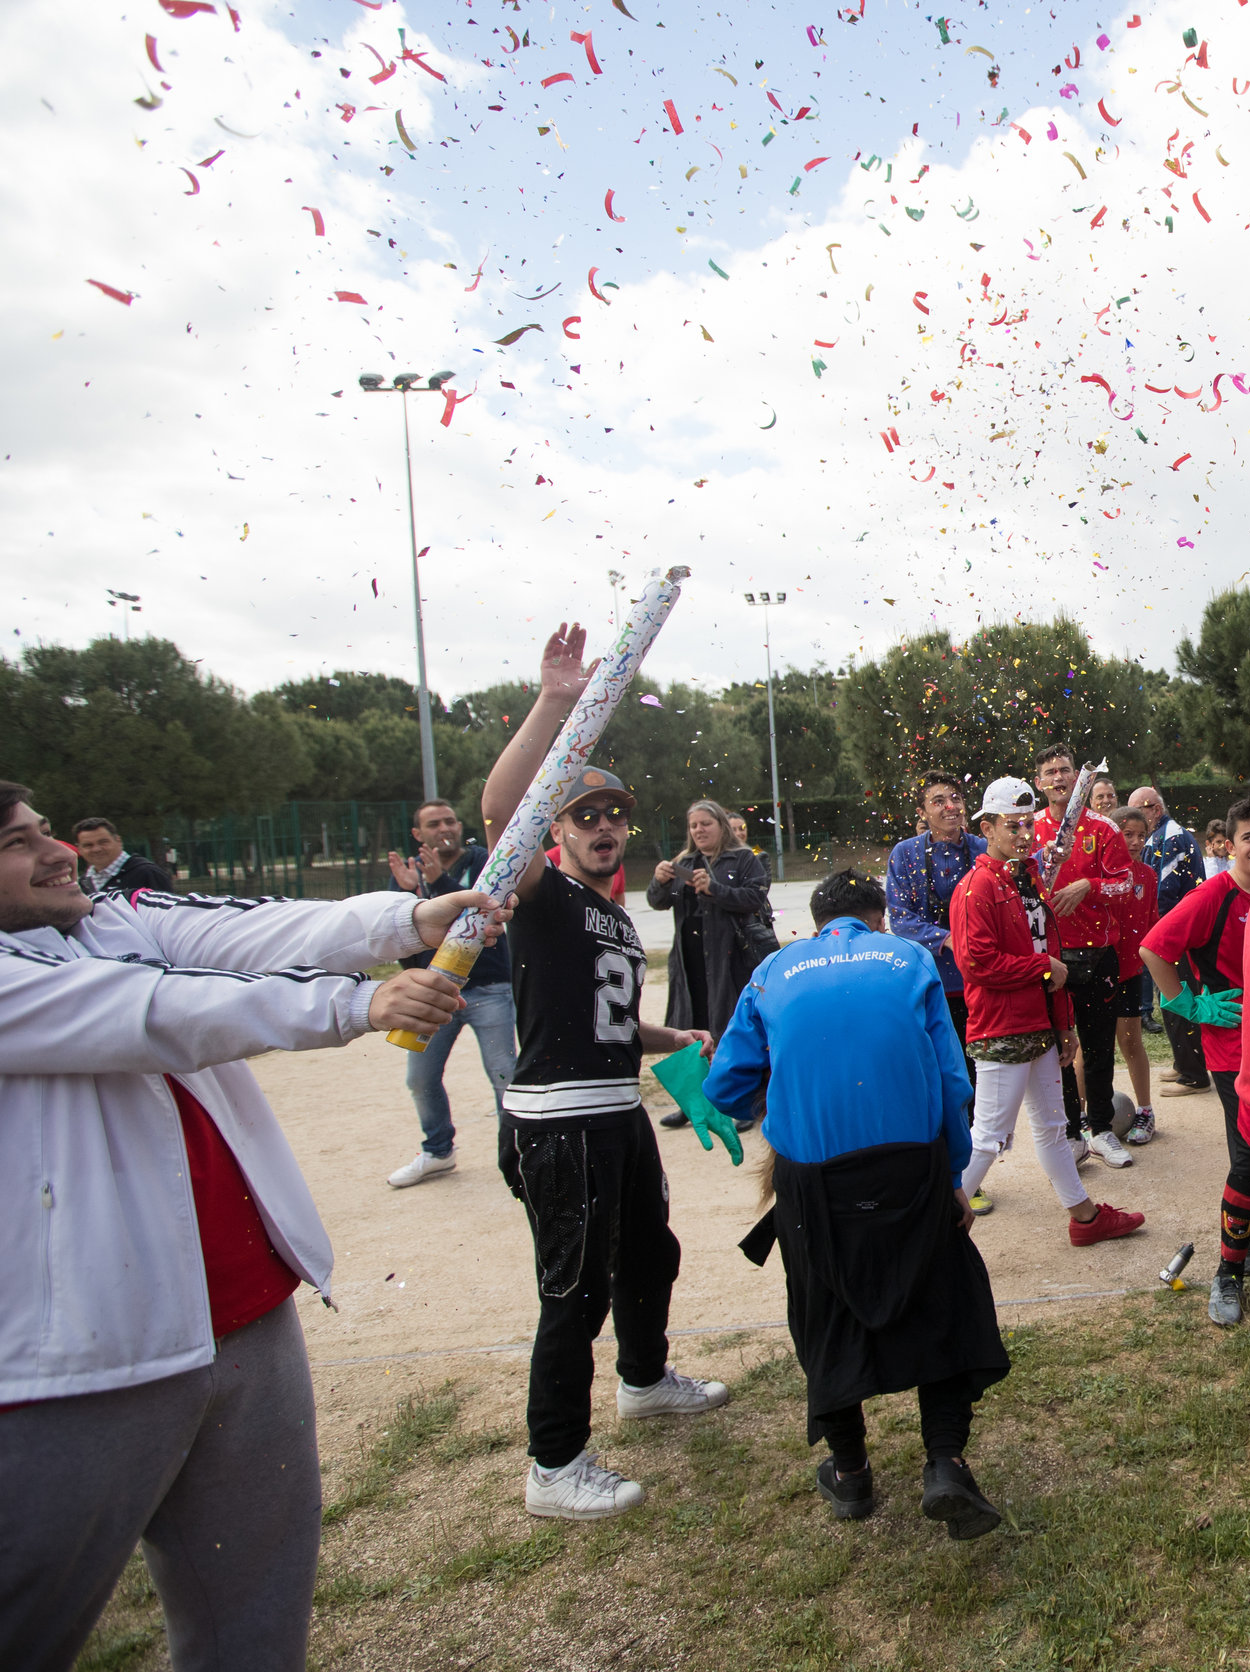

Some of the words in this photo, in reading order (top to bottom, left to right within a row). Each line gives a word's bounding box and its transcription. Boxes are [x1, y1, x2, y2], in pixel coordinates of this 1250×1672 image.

[784, 958, 826, 979] RACING
[829, 951, 892, 965] VILLAVERDE
[893, 958, 909, 970] CF
